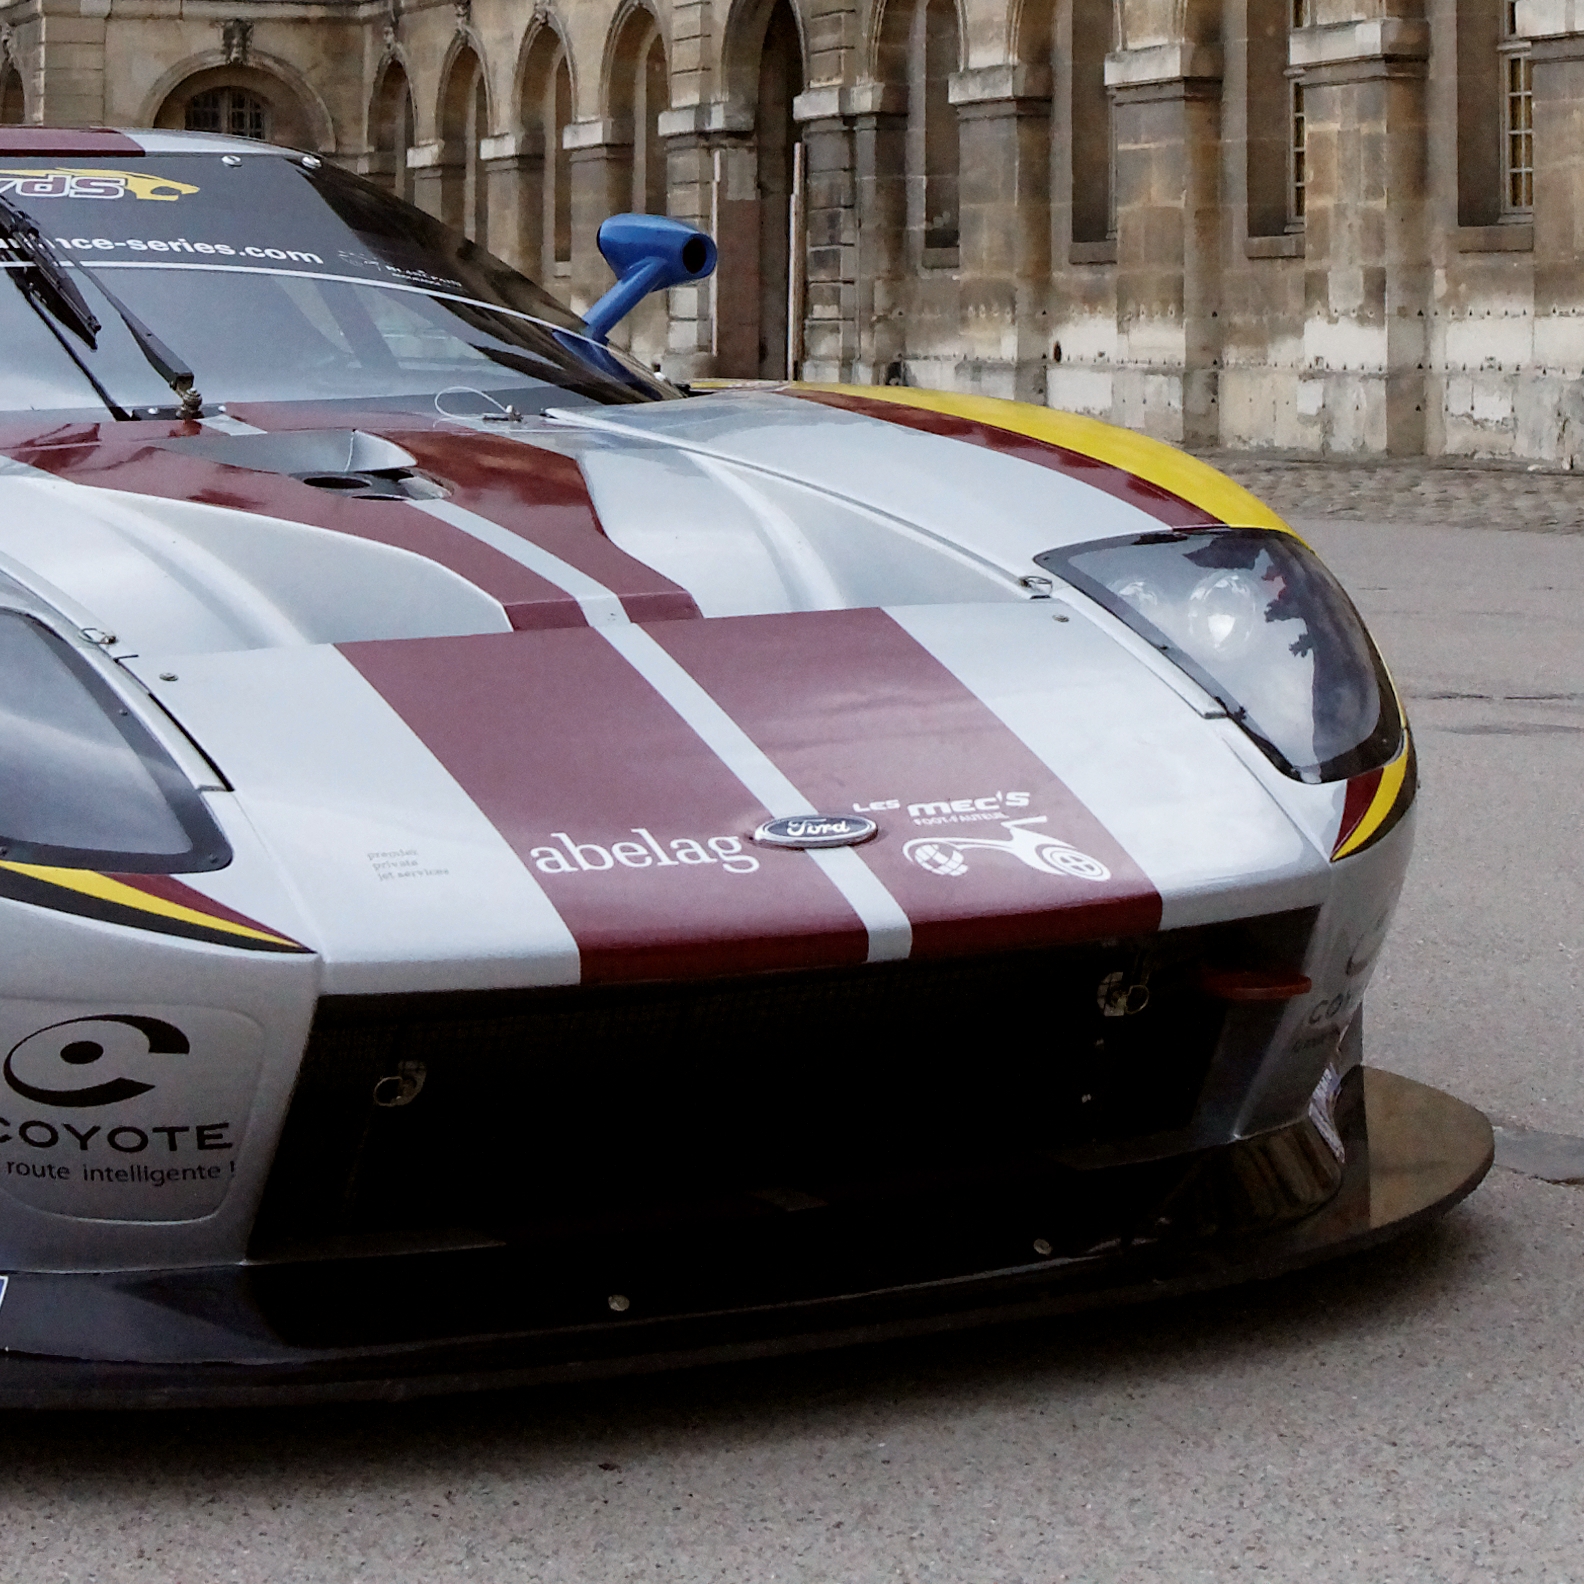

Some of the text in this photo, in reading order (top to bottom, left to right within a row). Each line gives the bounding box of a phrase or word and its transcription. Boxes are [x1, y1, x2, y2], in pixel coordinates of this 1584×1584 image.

[853, 799, 900, 813] LES
[787, 819, 850, 836] Ford
[530, 828, 760, 873] abelag
[8, 1159, 70, 1181] route
[83, 1164, 222, 1186] intelligente
